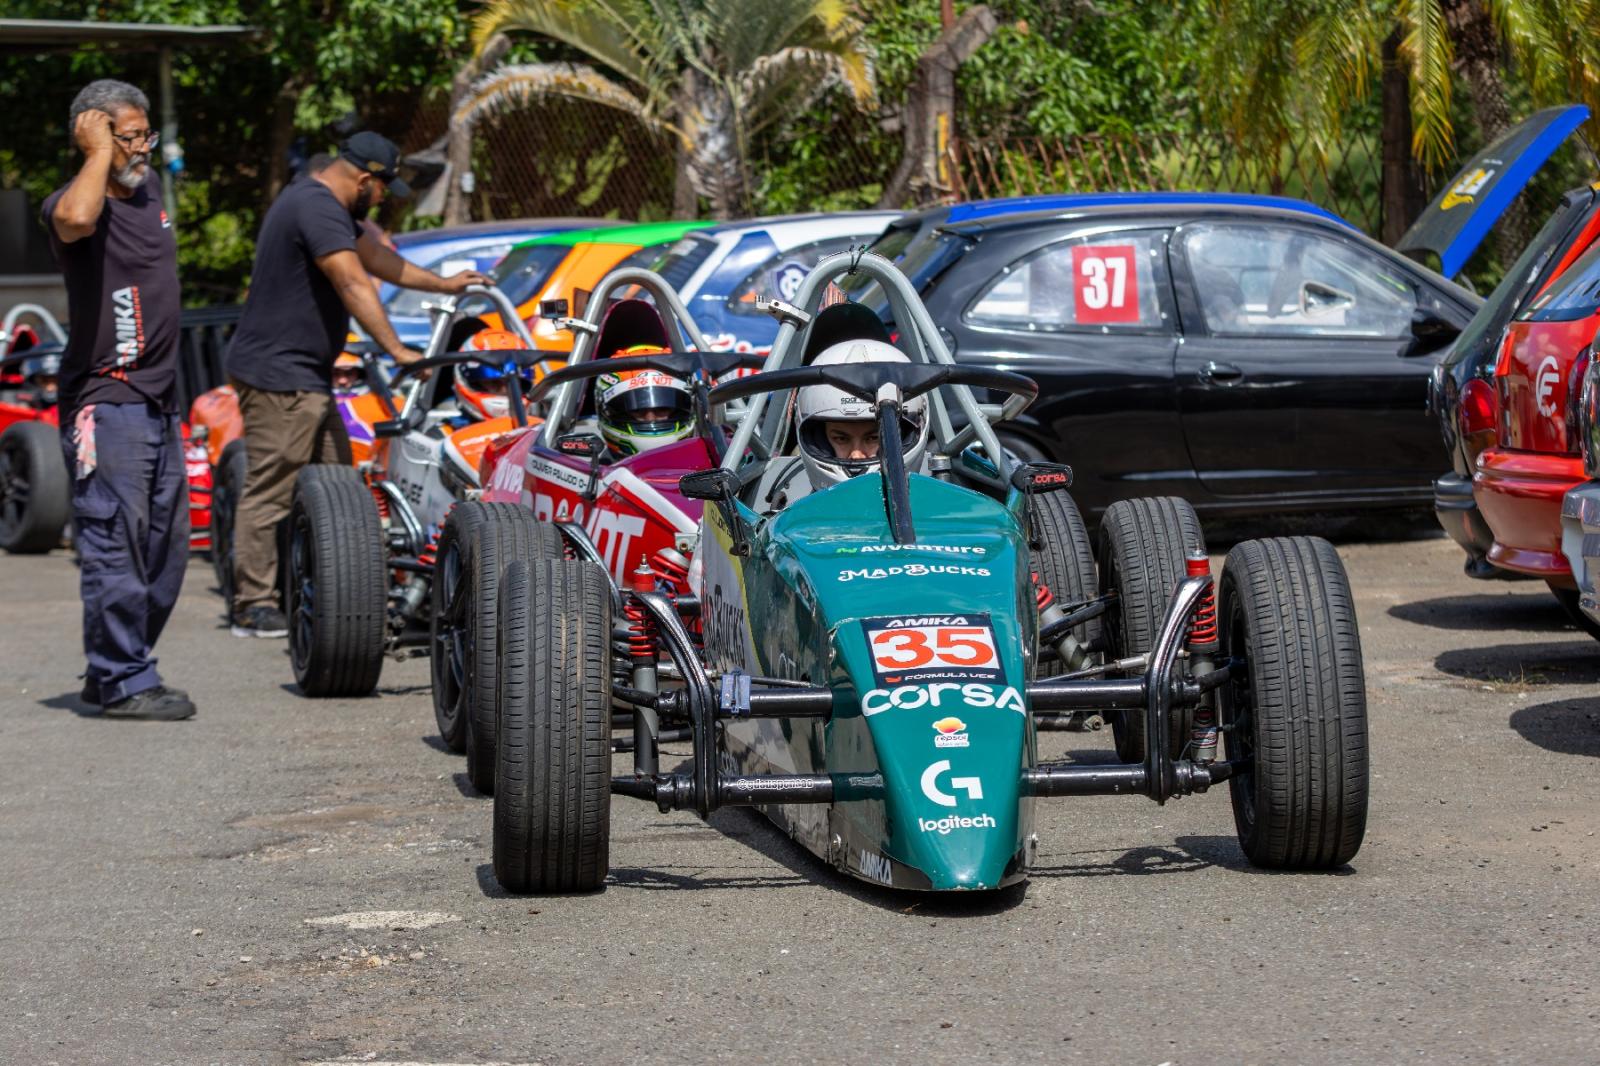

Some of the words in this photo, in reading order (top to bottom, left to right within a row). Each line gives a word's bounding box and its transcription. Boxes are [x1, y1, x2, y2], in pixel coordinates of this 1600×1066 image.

[1081, 257, 1127, 309] 37
[628, 375, 673, 388] BRNDT
[886, 616, 969, 628] AMIKA
[873, 628, 994, 669] 35
[904, 672, 968, 681] FORMULA
[918, 813, 997, 834] logitech
[858, 849, 893, 885] AMIKA
